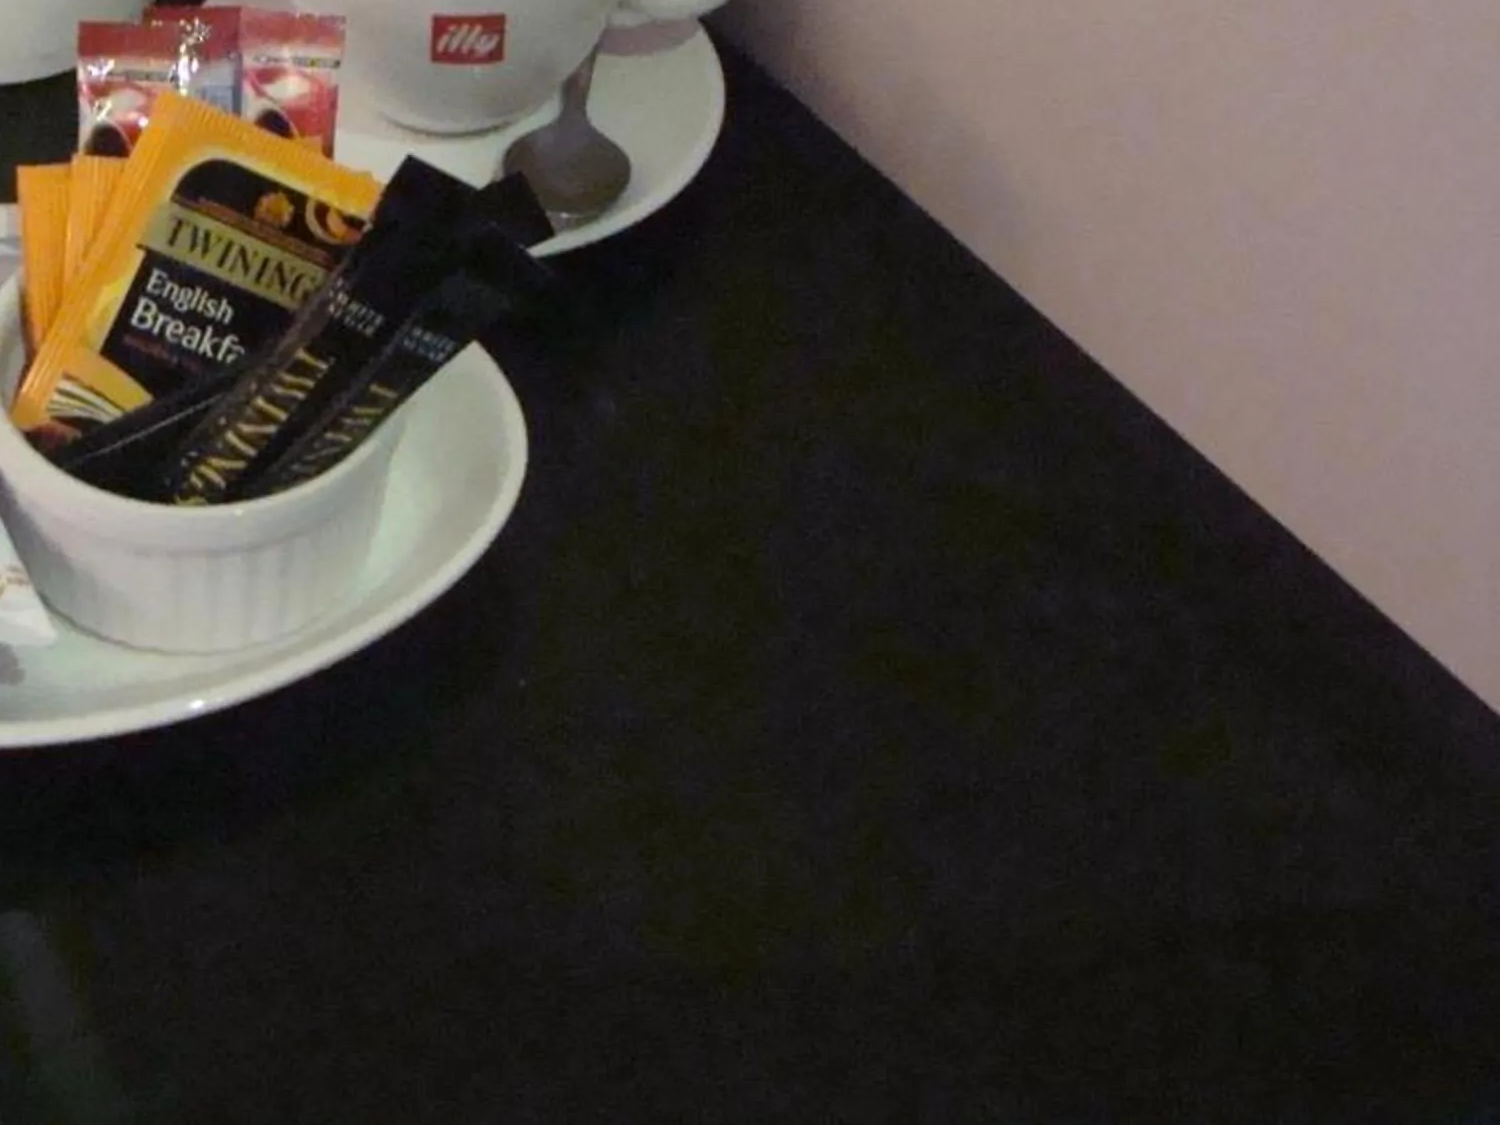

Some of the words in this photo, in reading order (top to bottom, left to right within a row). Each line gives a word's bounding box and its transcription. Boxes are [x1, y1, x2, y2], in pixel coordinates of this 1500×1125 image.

[436, 23, 499, 58] illy
[167, 217, 324, 306] TWINING
[147, 267, 235, 325] English
